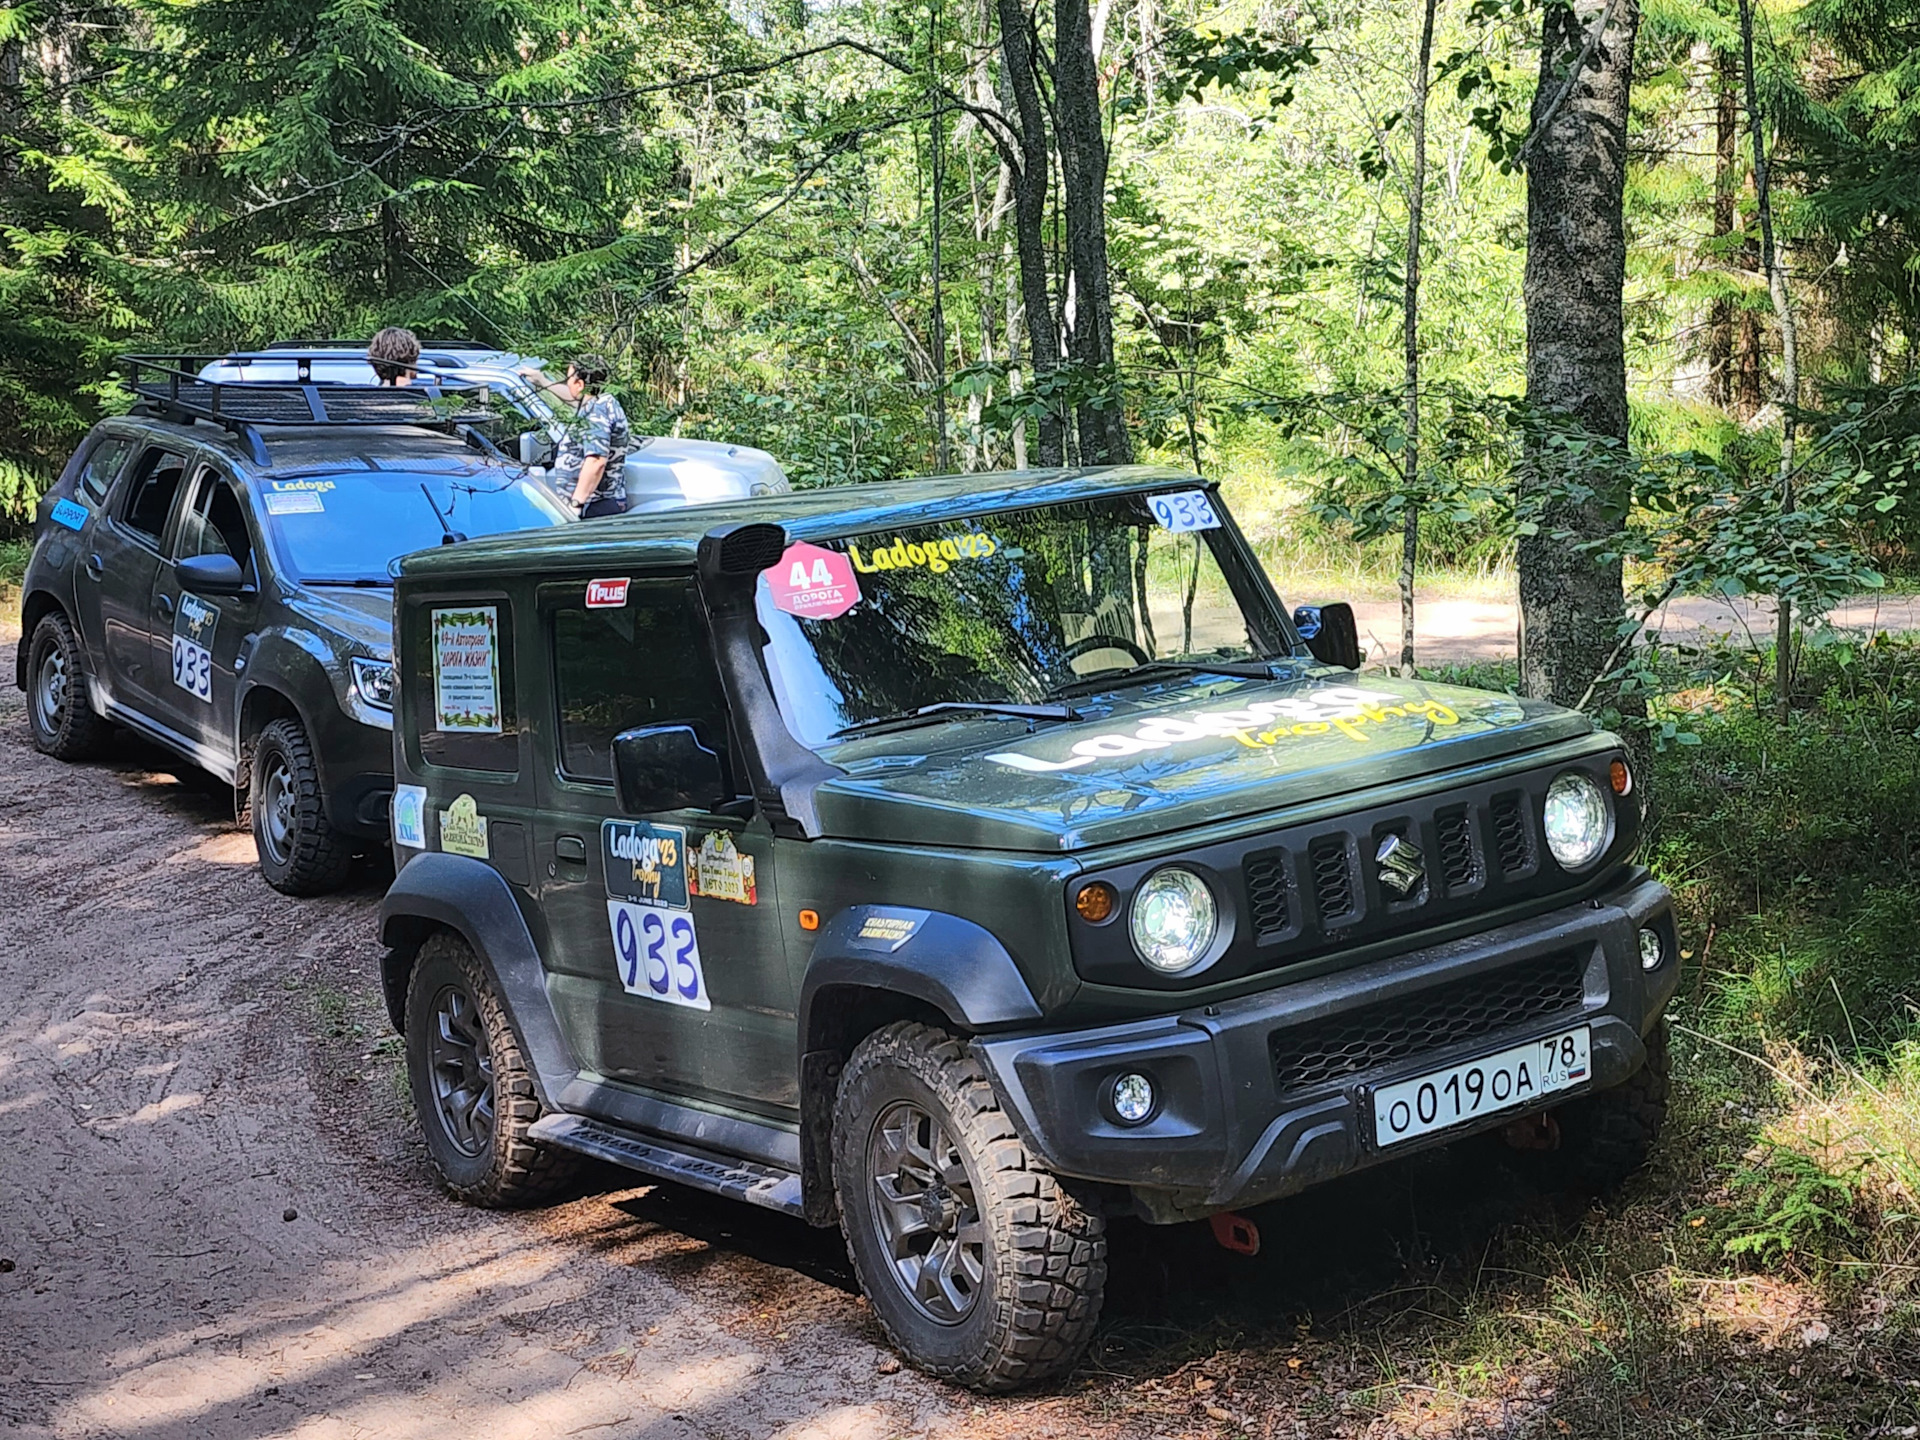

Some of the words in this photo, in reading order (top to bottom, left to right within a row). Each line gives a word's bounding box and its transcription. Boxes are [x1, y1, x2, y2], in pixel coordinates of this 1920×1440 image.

[272, 480, 336, 493] Ladoga
[1156, 494, 1213, 529] 933
[789, 558, 833, 590] 44
[793, 589, 842, 605] ДОРОГА
[174, 640, 210, 696] 933
[983, 687, 1404, 771] Ladoga
[616, 908, 699, 1000] 933
[1543, 1036, 1576, 1073] 78
[1543, 1070, 1567, 1088] RUS
